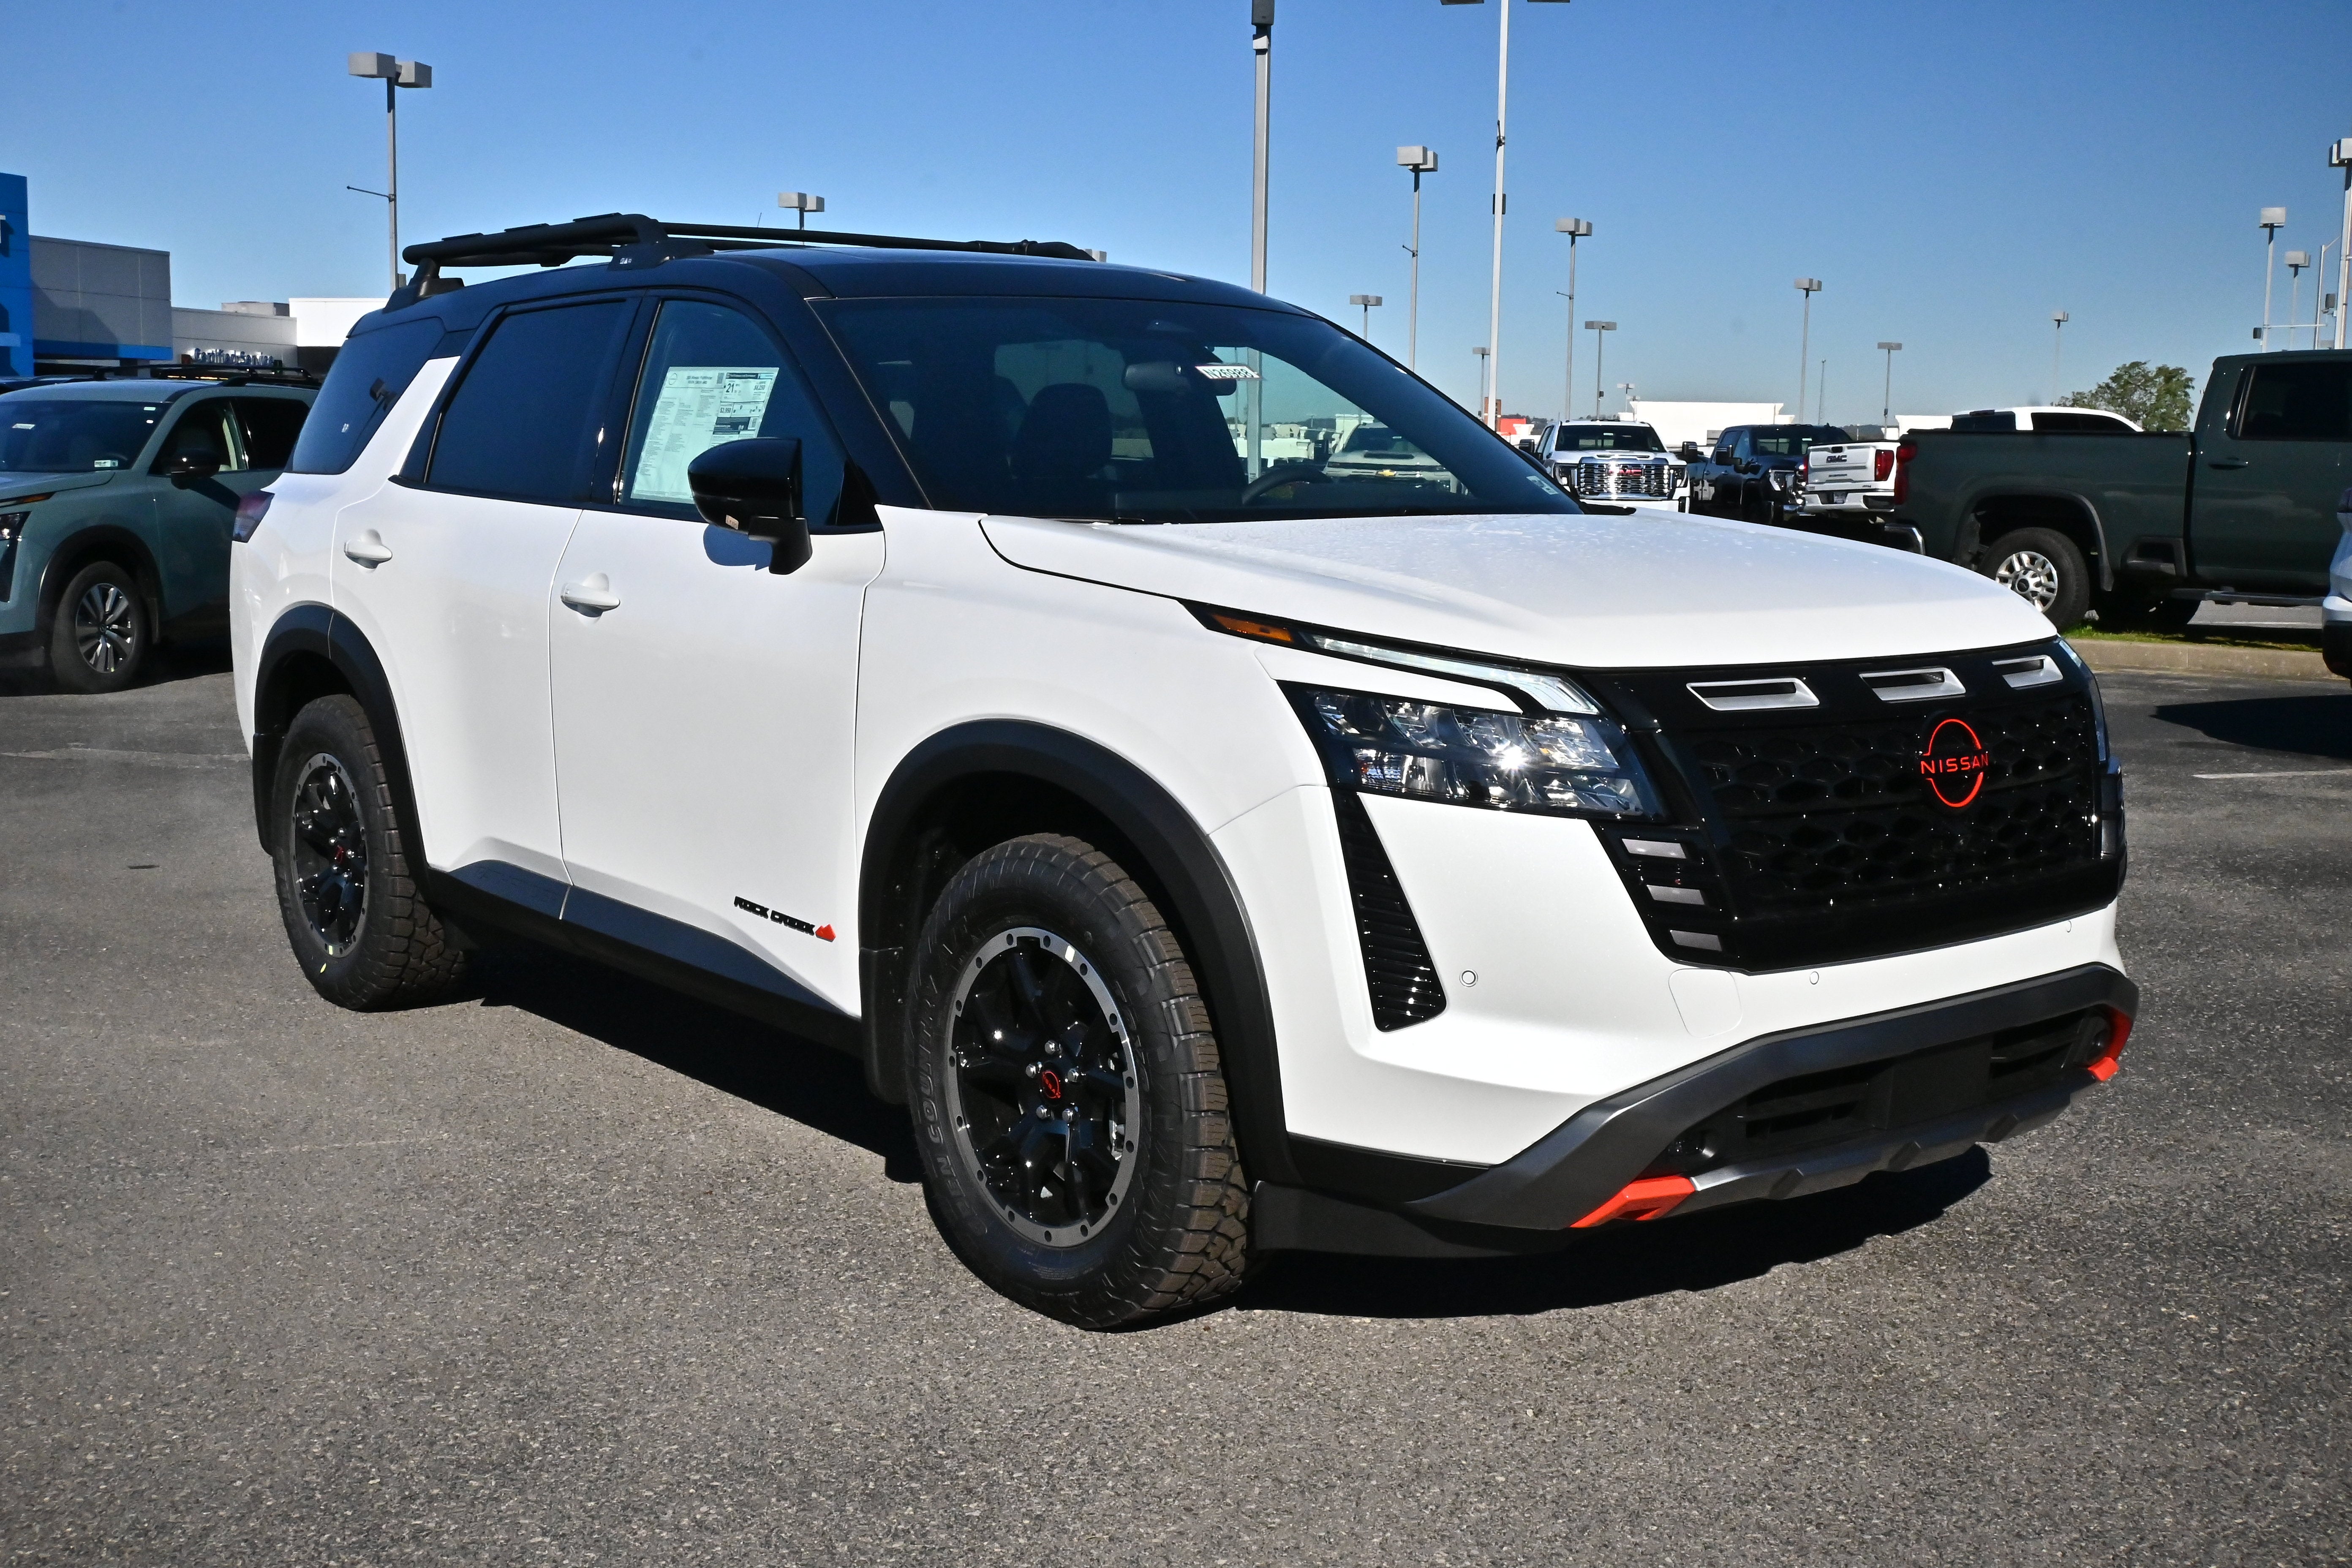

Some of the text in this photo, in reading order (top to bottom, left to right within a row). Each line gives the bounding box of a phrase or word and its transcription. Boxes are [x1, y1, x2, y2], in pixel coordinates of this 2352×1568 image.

[1203, 369, 1254, 378] N26988
[1826, 455, 1847, 463] GMC
[1920, 753, 1989, 774] NISSAN
